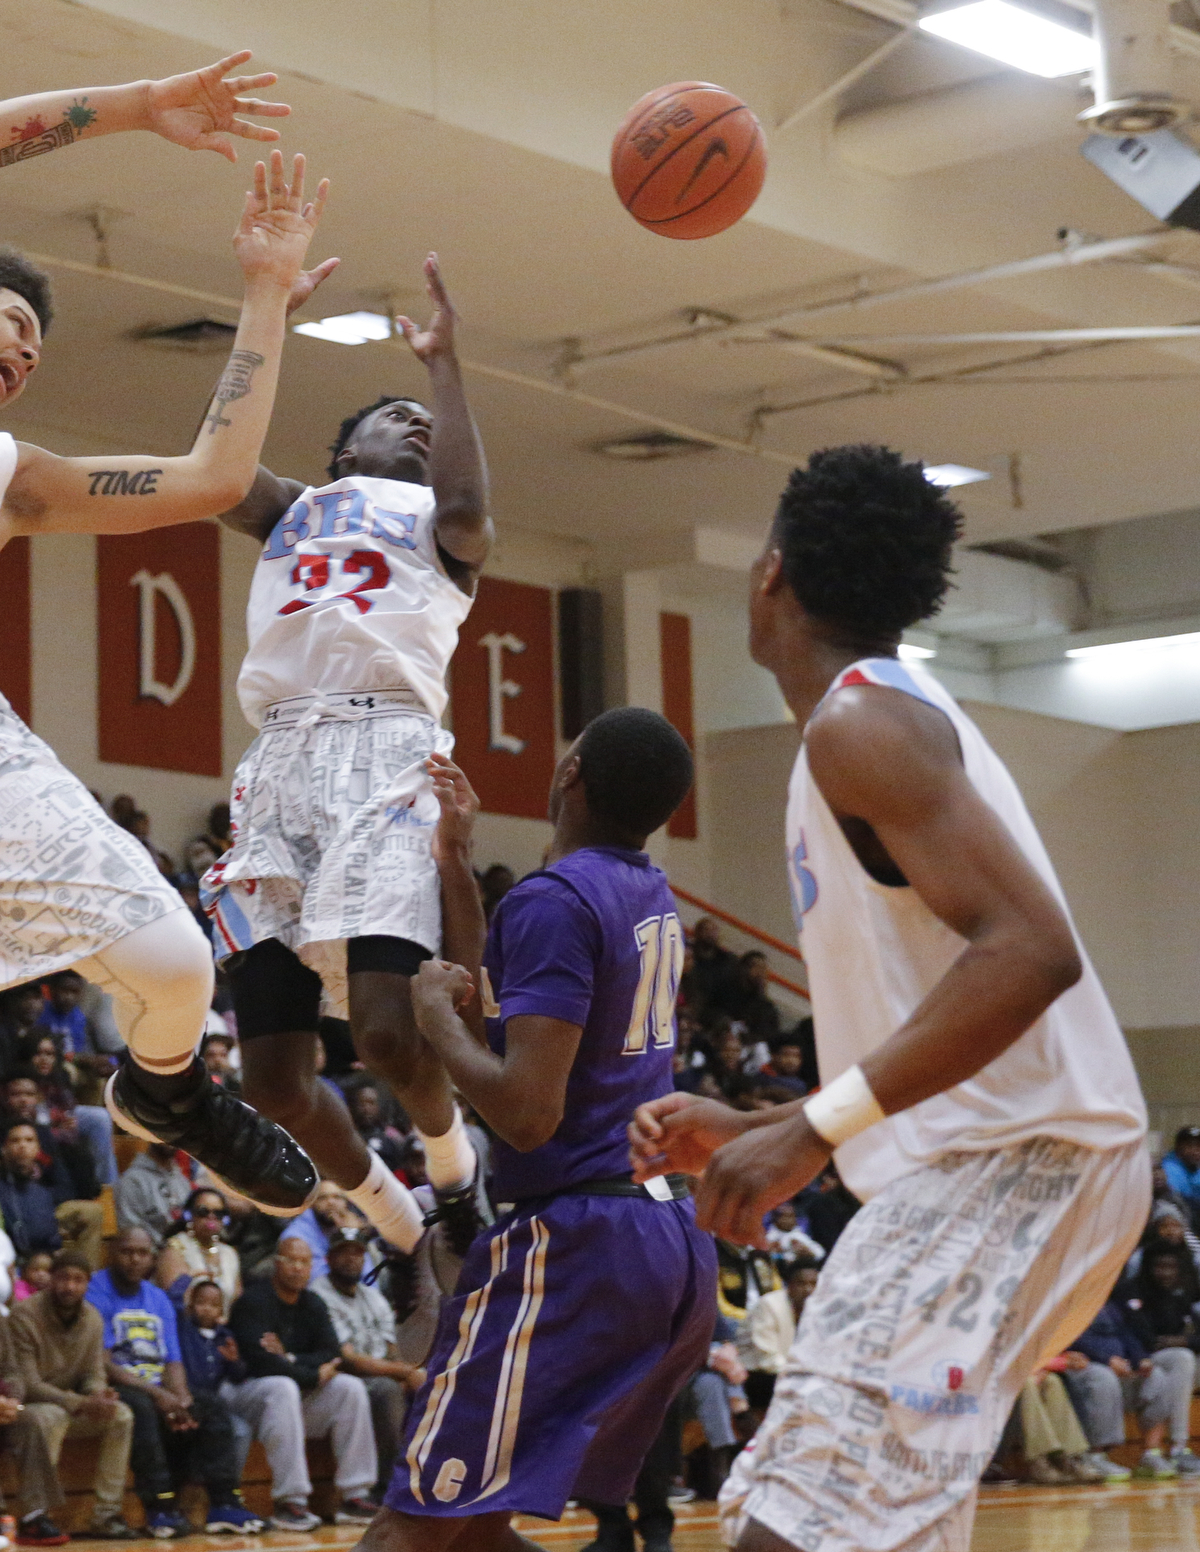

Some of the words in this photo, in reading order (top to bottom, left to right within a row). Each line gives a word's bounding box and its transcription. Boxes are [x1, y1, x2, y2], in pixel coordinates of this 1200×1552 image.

[87, 469, 162, 496] TIME
[263, 489, 418, 561] BHS
[130, 568, 197, 707] D
[477, 630, 527, 756] E
[621, 912, 685, 1055] 10
